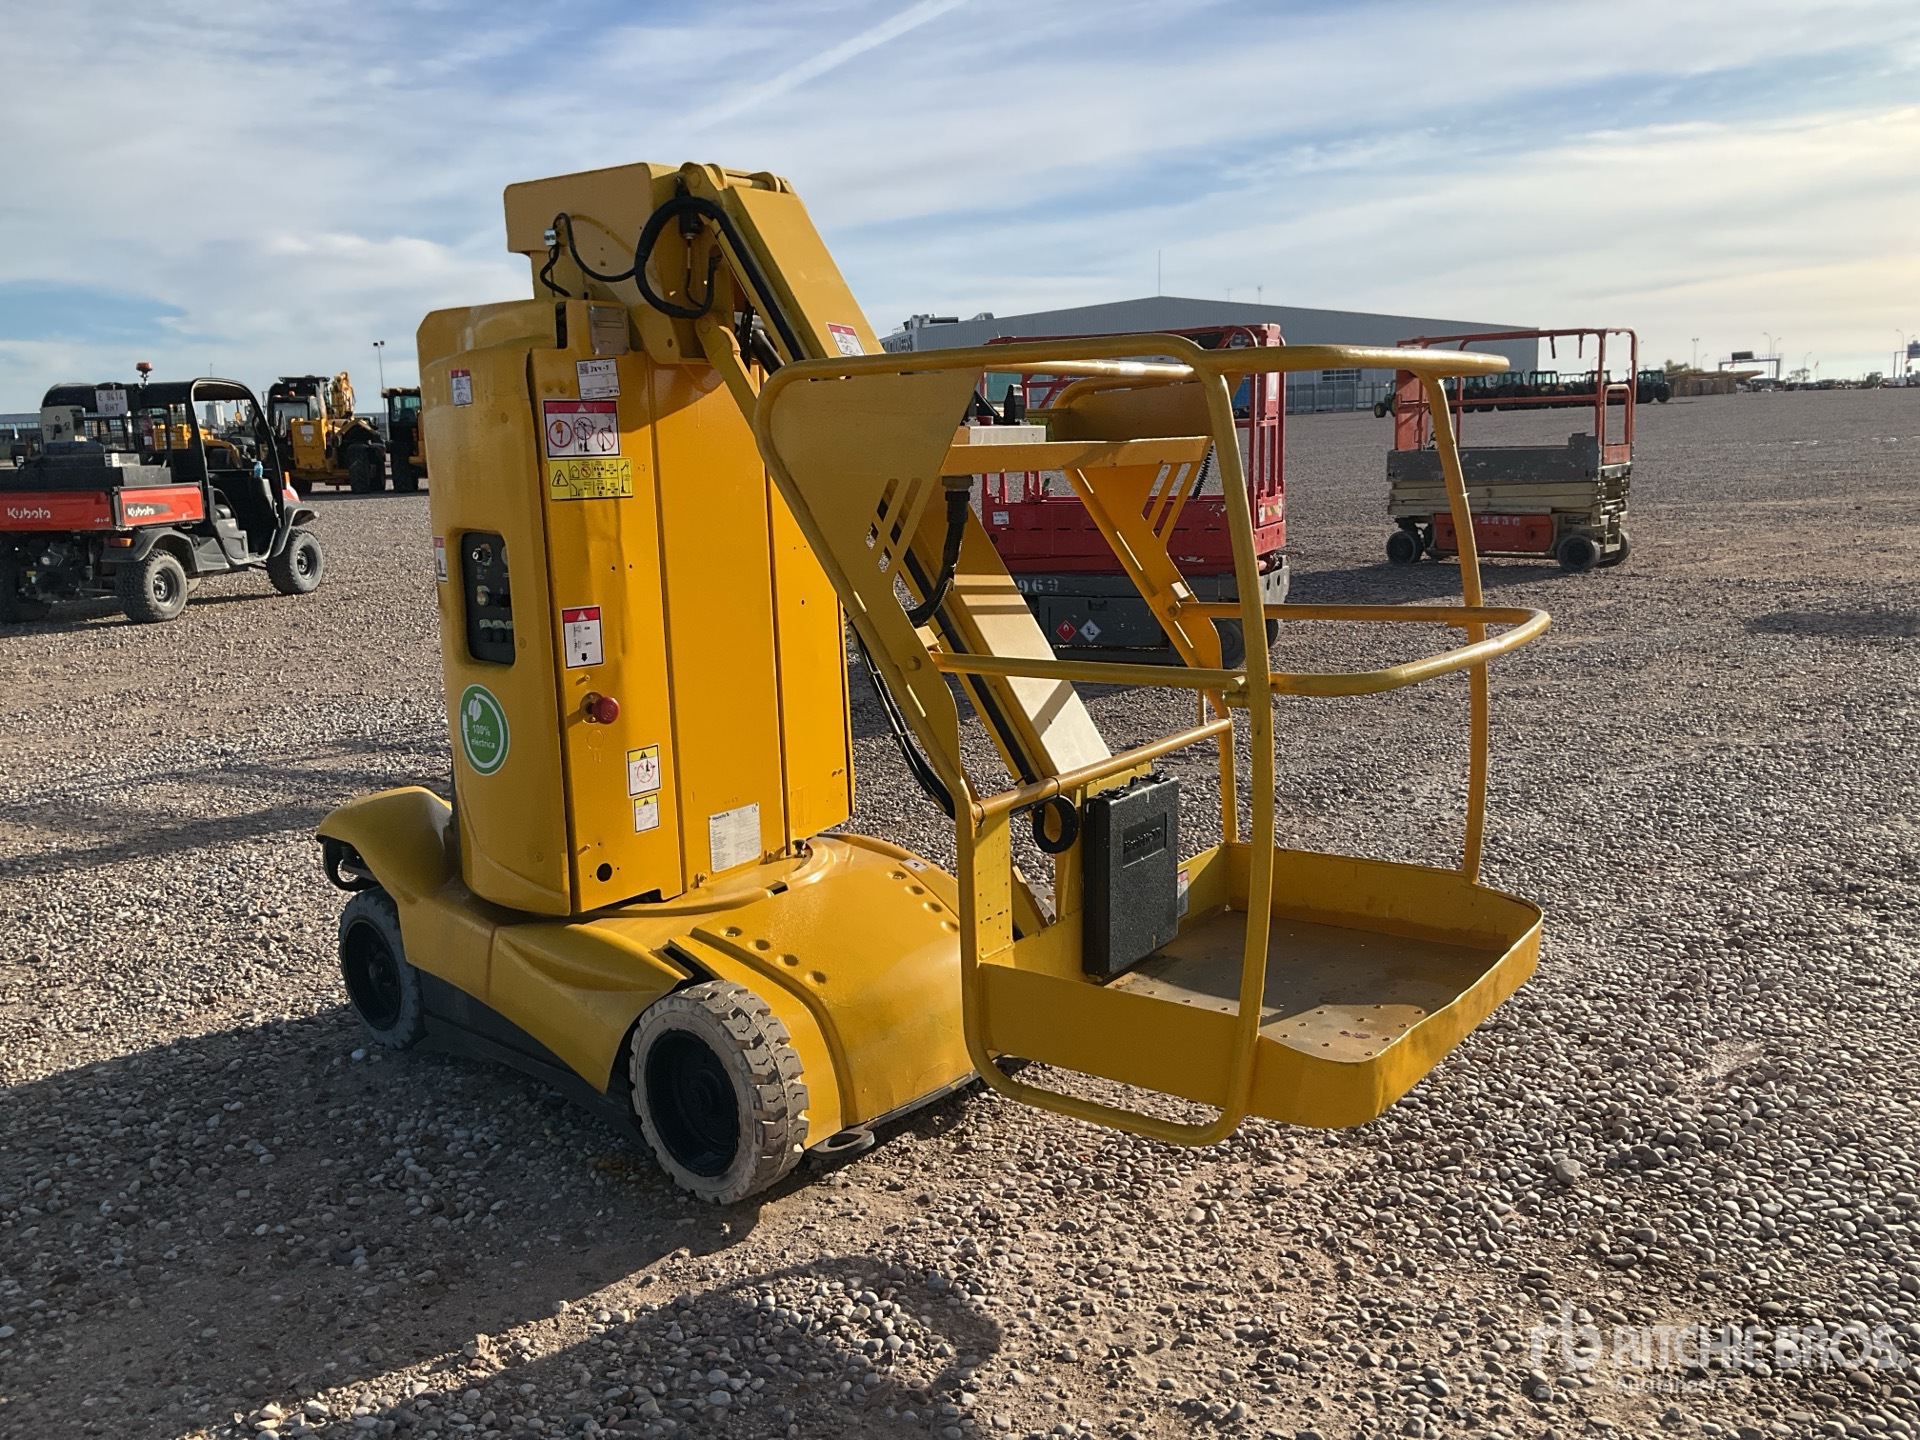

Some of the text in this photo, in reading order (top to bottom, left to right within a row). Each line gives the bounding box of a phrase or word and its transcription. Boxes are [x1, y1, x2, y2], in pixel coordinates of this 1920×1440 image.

[7, 507, 51, 519] Kubota
[127, 506, 155, 517] Kubota
[472, 724, 490, 736] 100%
